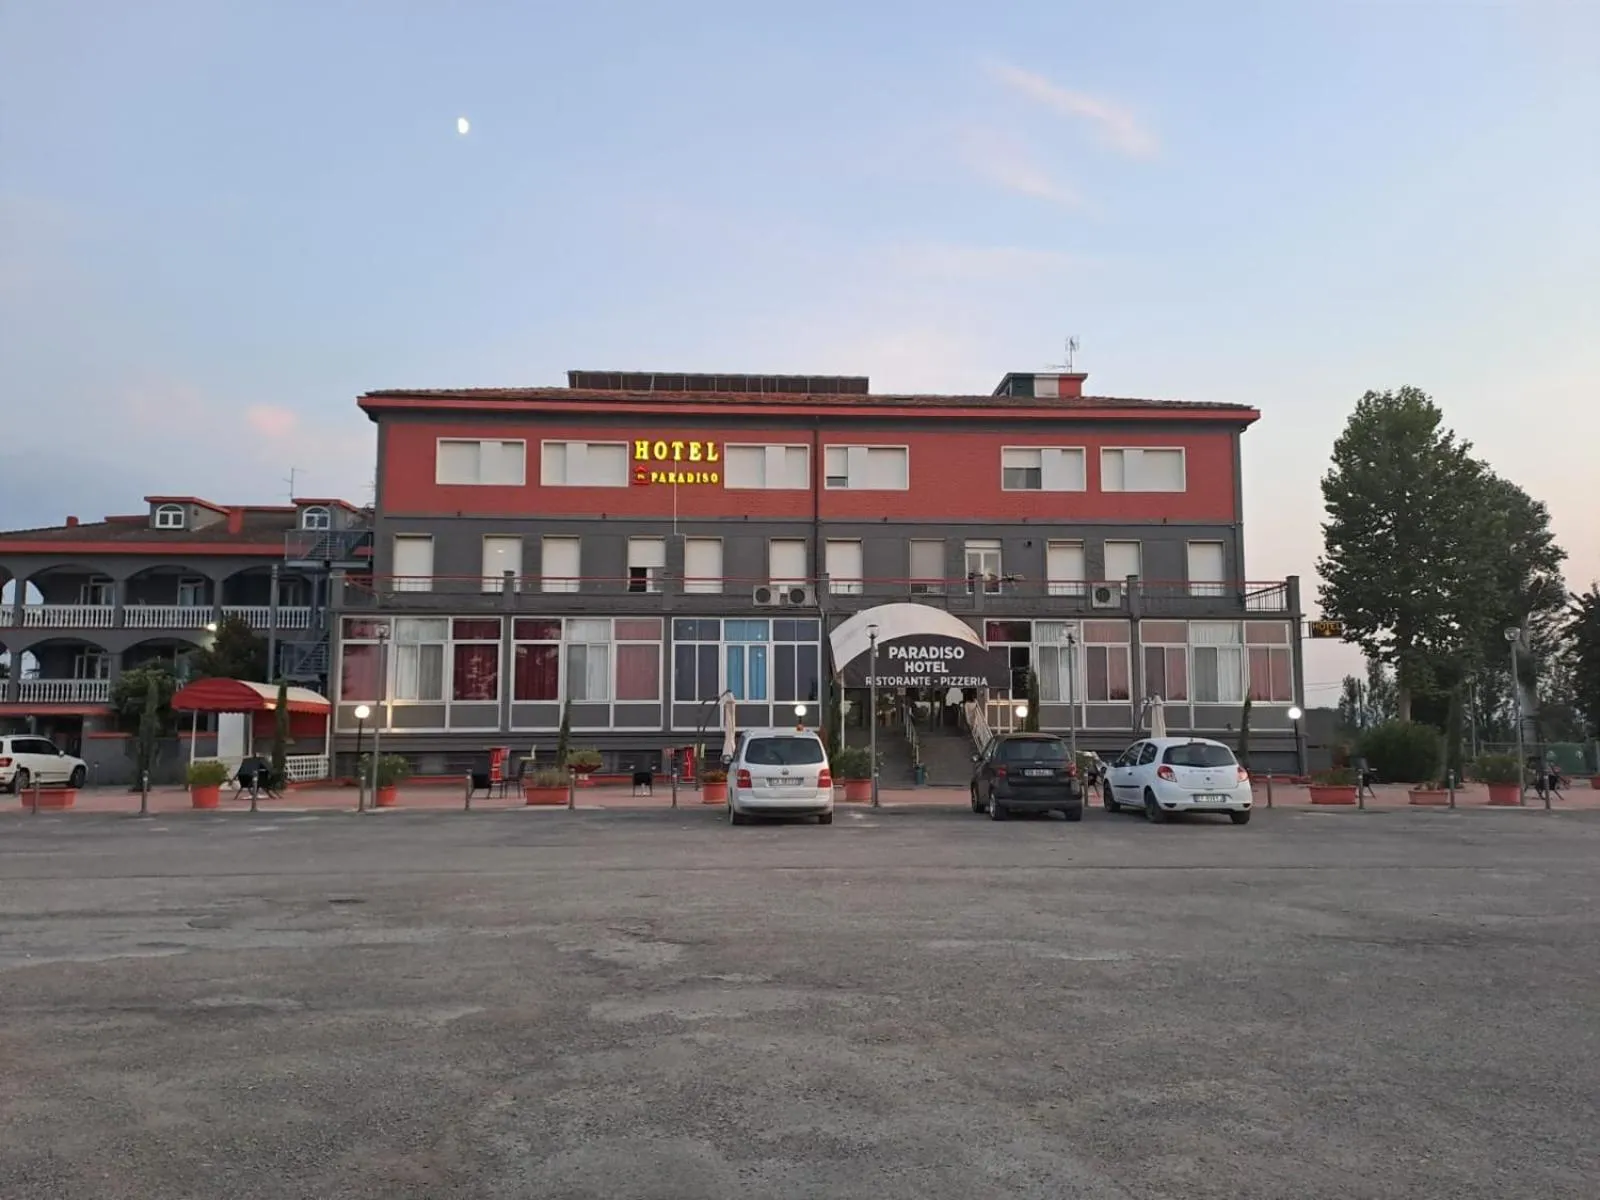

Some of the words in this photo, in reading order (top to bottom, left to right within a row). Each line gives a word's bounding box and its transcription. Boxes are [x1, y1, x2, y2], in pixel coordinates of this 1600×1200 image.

[635, 440, 718, 461] HOTEL
[651, 472, 718, 483] PARADISO
[888, 646, 965, 659] PARADISO
[904, 661, 949, 673] HOTEL
[865, 676, 931, 686] RSTORANTE
[940, 676, 988, 686] PIZZERIA
